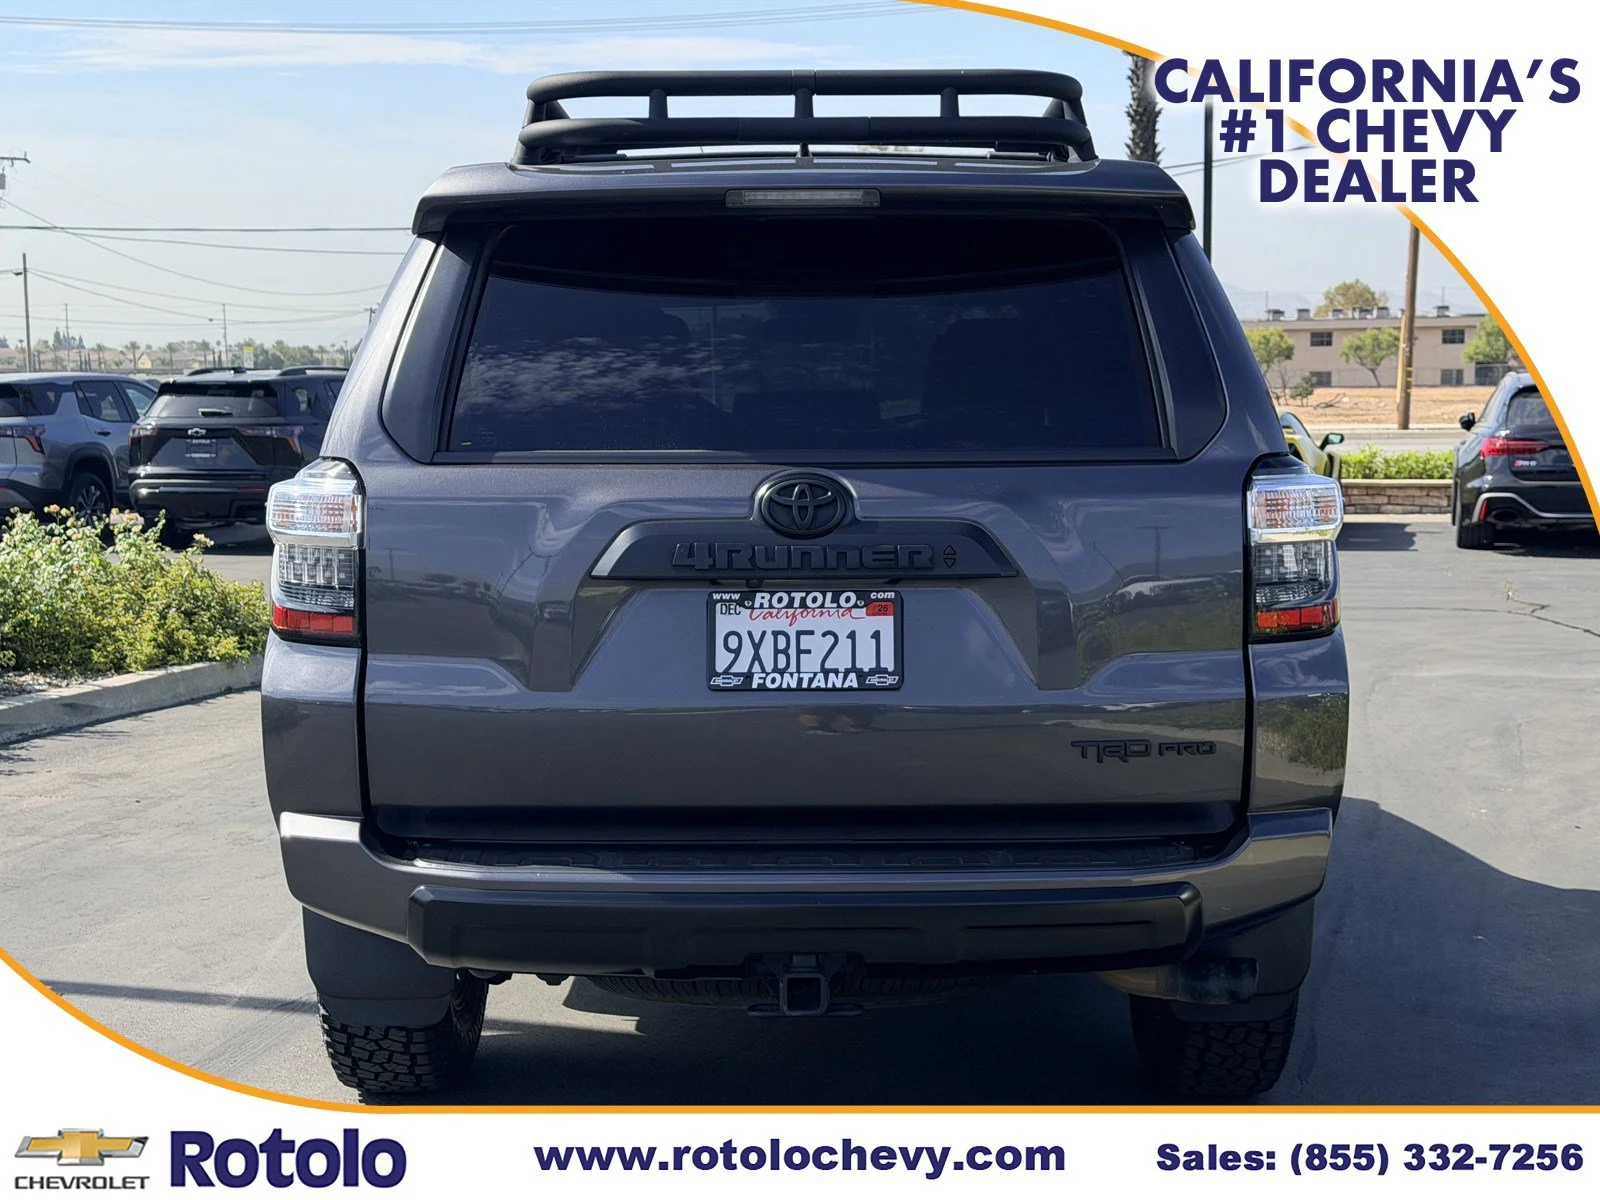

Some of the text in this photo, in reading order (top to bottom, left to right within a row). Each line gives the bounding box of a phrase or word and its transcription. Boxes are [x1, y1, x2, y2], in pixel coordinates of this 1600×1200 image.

[753, 591, 857, 609] ROTOLO
[720, 603, 741, 616] DEC
[722, 630, 889, 673] 9XBF211
[751, 672, 859, 689] FONTANA
[1070, 738, 1217, 764] TRD PRO
